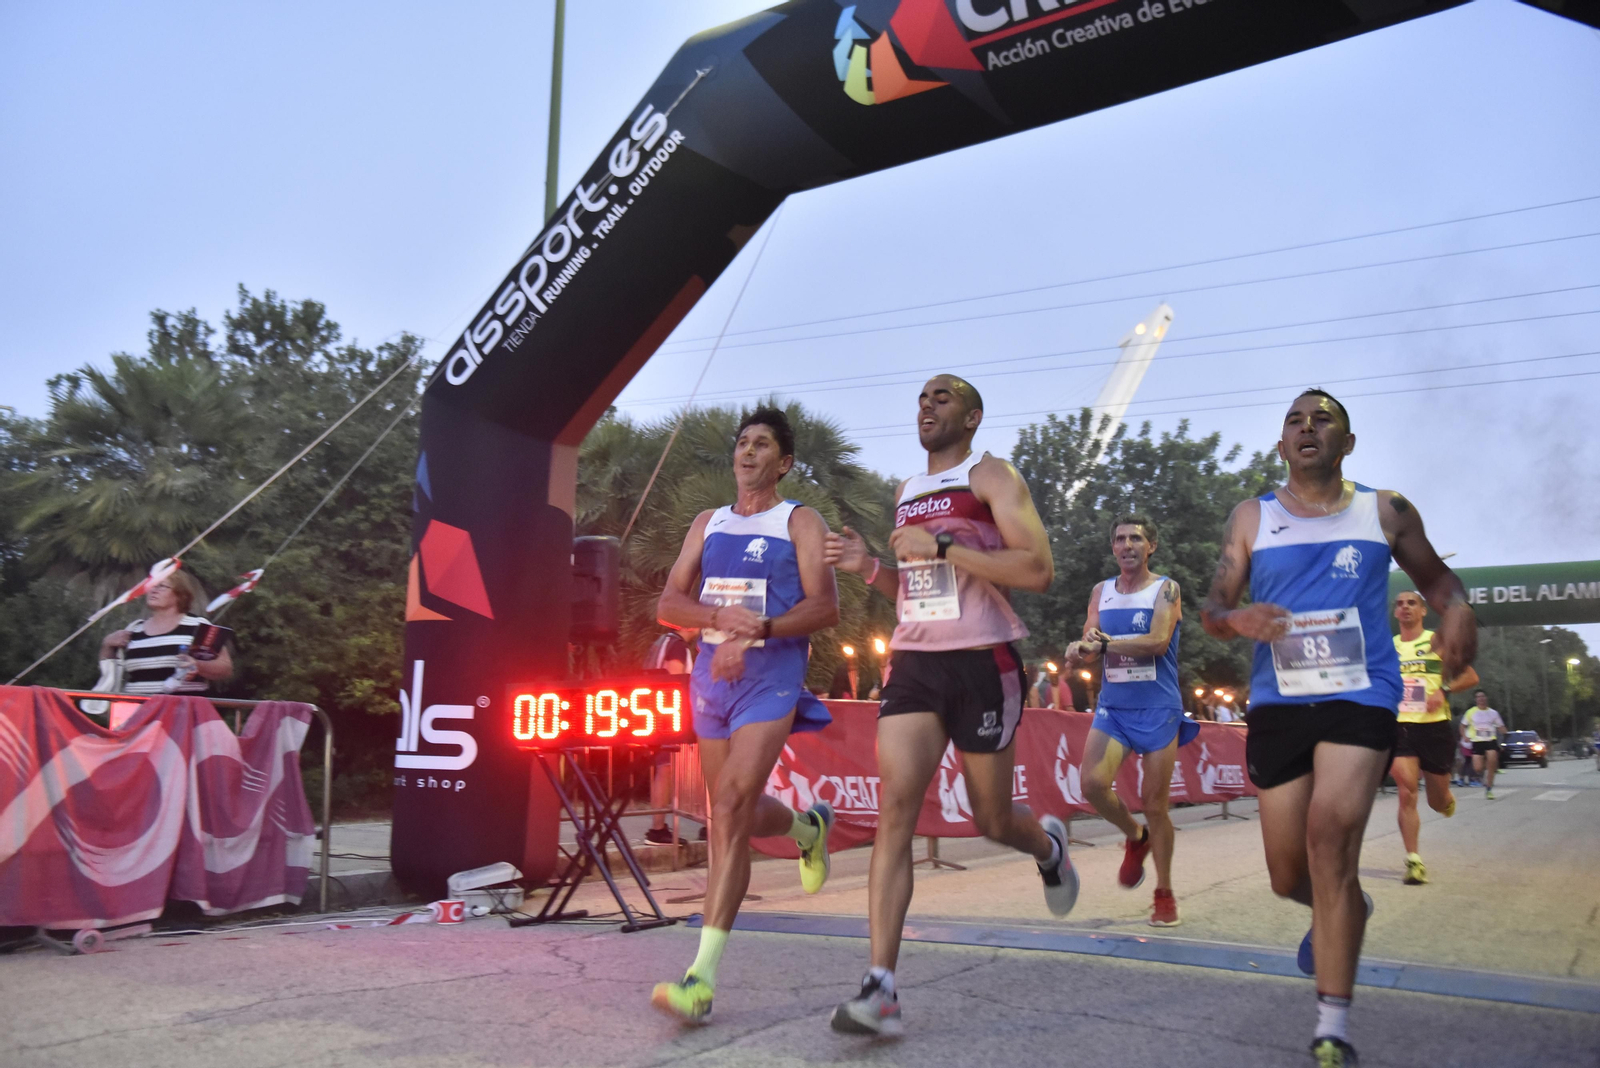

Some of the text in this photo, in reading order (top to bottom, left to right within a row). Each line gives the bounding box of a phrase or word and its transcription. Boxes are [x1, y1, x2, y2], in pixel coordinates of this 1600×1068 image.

[987, 38, 1050, 70] Acción
[1051, 14, 1134, 49] Creativa
[1137, 0, 1166, 23] de
[502, 129, 686, 352] TIENDA RUNNING TRAIL OUTDOOR
[908, 497, 951, 517] Getxo
[907, 569, 933, 591] 255
[1493, 586, 1532, 603] DEL
[1536, 582, 1600, 601] ALAM
[1303, 635, 1331, 659] 83
[513, 688, 682, 740] 00:19:54
[416, 776, 466, 792] shop
[812, 775, 880, 810] CREAT
